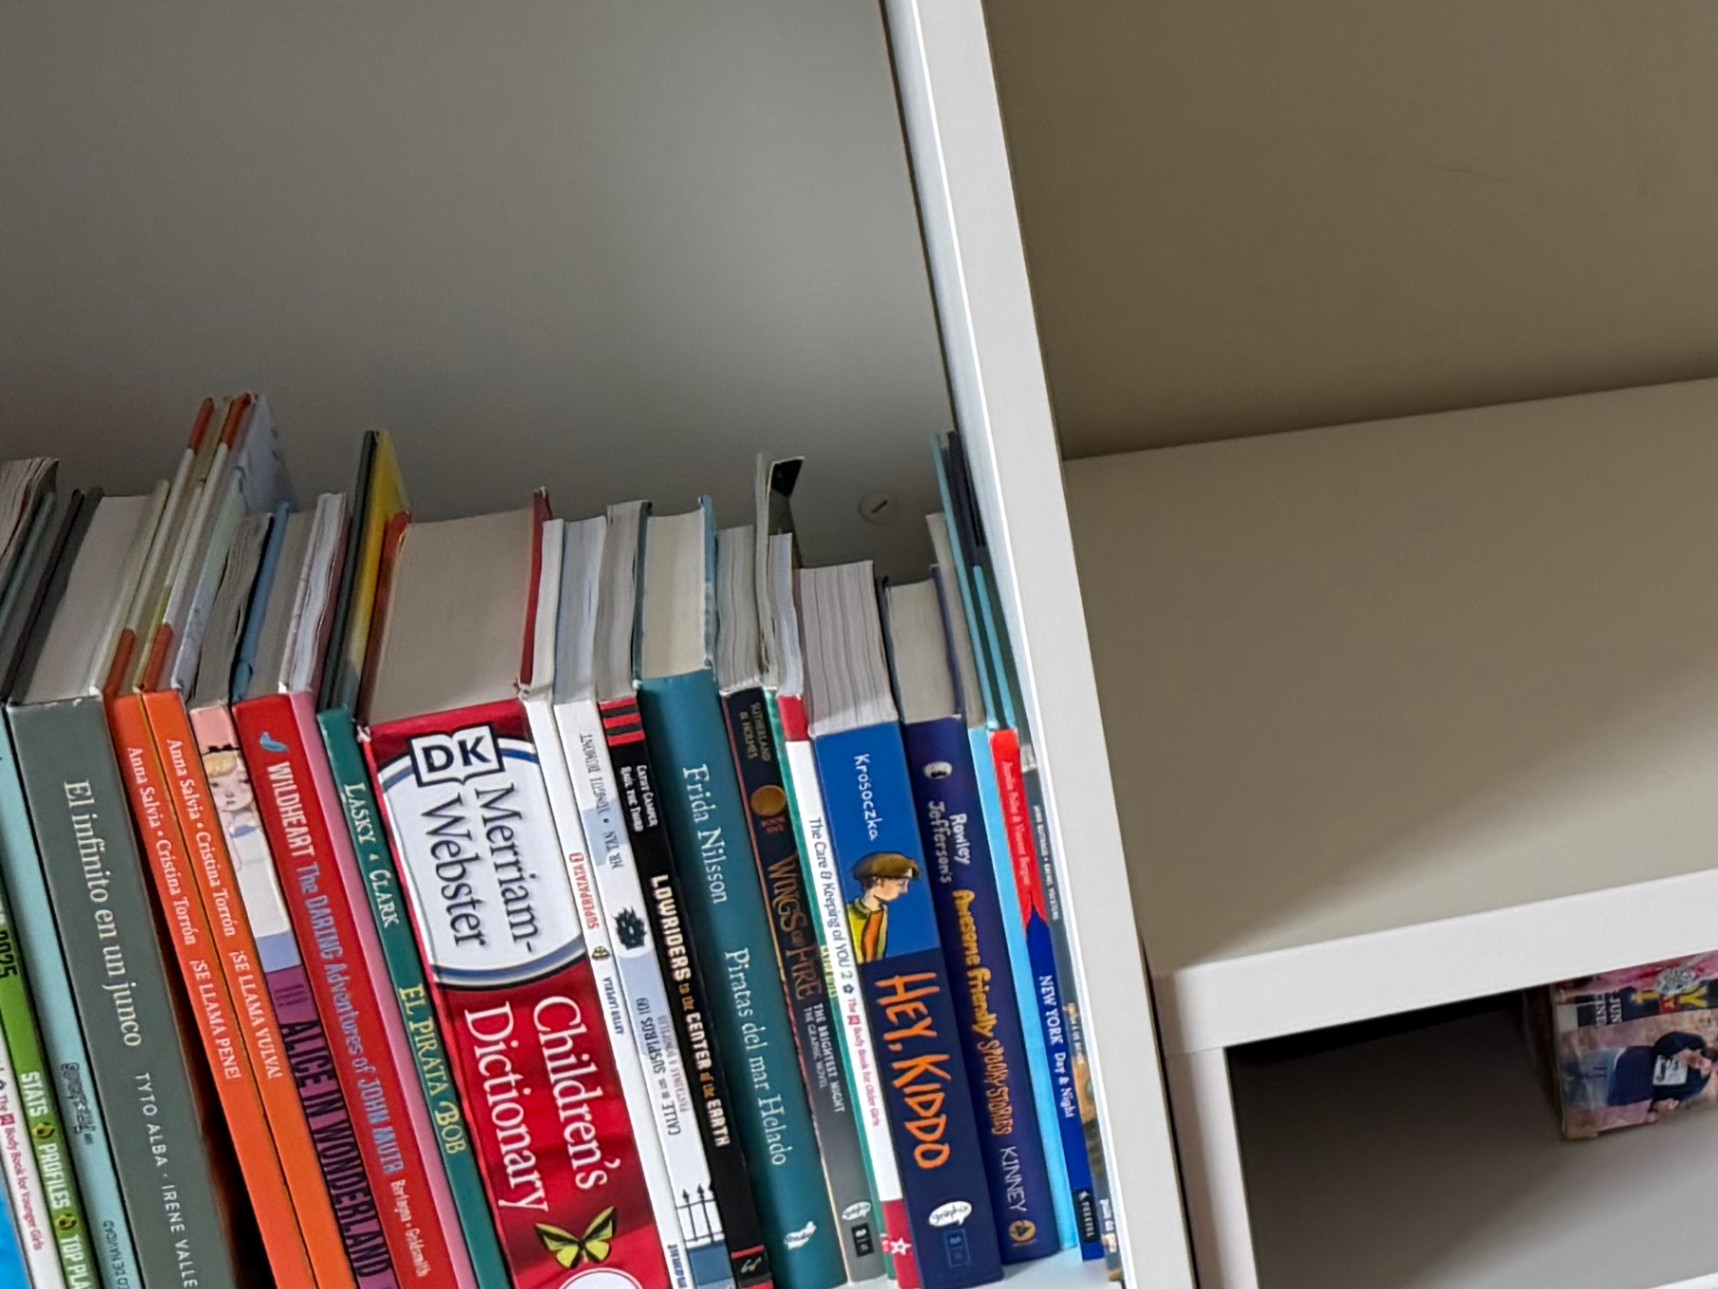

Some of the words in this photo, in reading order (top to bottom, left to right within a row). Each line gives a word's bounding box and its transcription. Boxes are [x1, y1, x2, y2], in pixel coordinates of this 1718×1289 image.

[64, 779, 94, 809] El
[267, 761, 316, 857] WILDHEART
[683, 764, 716, 822] Frida
[854, 754, 879, 842] Krosoczka
[72, 813, 111, 903] infinito
[128, 747, 148, 785] Anna
[140, 786, 161, 829] Salvia
[155, 839, 181, 896] Cristina
[173, 897, 197, 946] Torrón
[167, 739, 187, 777] Anna
[179, 778, 200, 820] Salvia
[196, 831, 220, 888] Cristina
[212, 889, 237, 937] Torrón
[344, 782, 375, 844] LASKY
[369, 869, 400, 929] CLARK
[420, 790, 487, 948] Webster
[475, 779, 541, 955] Merriam-
[604, 830, 620, 851] TAN
[698, 827, 728, 905] Nilsson
[928, 801, 953, 884] Jefferson's
[951, 813, 971, 865] Rowley
[297, 861, 318, 894] The
[573, 859, 599, 930] SUPERPATATA
[814, 842, 828, 873] Care
[823, 880, 840, 928] Keeping
[95, 909, 116, 940] en
[304, 894, 345, 959] DARING
[767, 856, 803, 931] WINGS
[786, 945, 822, 1000] FIRE
[103, 944, 126, 978] un
[725, 948, 753, 1018] Piratas
[953, 889, 981, 966] Awesome
[967, 966, 998, 1038] Friendly
[1039, 976, 1055, 1006] NEW
[102, 981, 142, 1047] junco
[200, 980, 227, 1036] LLAMA
[215, 1037, 242, 1080] PENE!
[239, 974, 265, 1025] LLAMA
[255, 1026, 283, 1080] VULVA!
[325, 962, 364, 1055] Adventures
[399, 983, 425, 1015] EL
[651, 874, 692, 983] LOWRIDERS
[686, 1013, 713, 1070] CENTER
[707, 1099, 730, 1148] EARTH
[875, 972, 941, 1051] HEY,
[1045, 1008, 1064, 1045] YORK
[408, 1017, 449, 1096] PIRATA
[640, 1016, 666, 1075] SUSPIROS
[742, 1023, 767, 1050] del
[818, 1024, 838, 1076] BRIGHTEST
[358, 1078, 390, 1124] JOHN
[464, 1001, 550, 1214] Dictionary
[533, 995, 621, 1192] Children's
[751, 1056, 771, 1091] mar
[1061, 1087, 1077, 1118] Night
[434, 1100, 467, 1154] BOB
[661, 1100, 682, 1136] CALLE
[758, 1095, 791, 1167] Helado
[891, 1054, 952, 1169] KIDDO
[21, 1071, 48, 1118] STATS
[38, 1142, 72, 1209] PROFILES
[60, 1234, 85, 1261] TOP
[135, 1071, 158, 1117] TYTO
[147, 1123, 169, 1168] ALBA
[161, 1184, 185, 1233] IRENE
[281, 1021, 337, 1088] ALICE
[314, 1120, 391, 1278] WONDERLAND
[372, 1125, 405, 1175] MUIR
[1000, 1146, 1028, 1213] KINNEY
[20, 1190, 38, 1230] Younger
[29, 1228, 44, 1252] Girls
